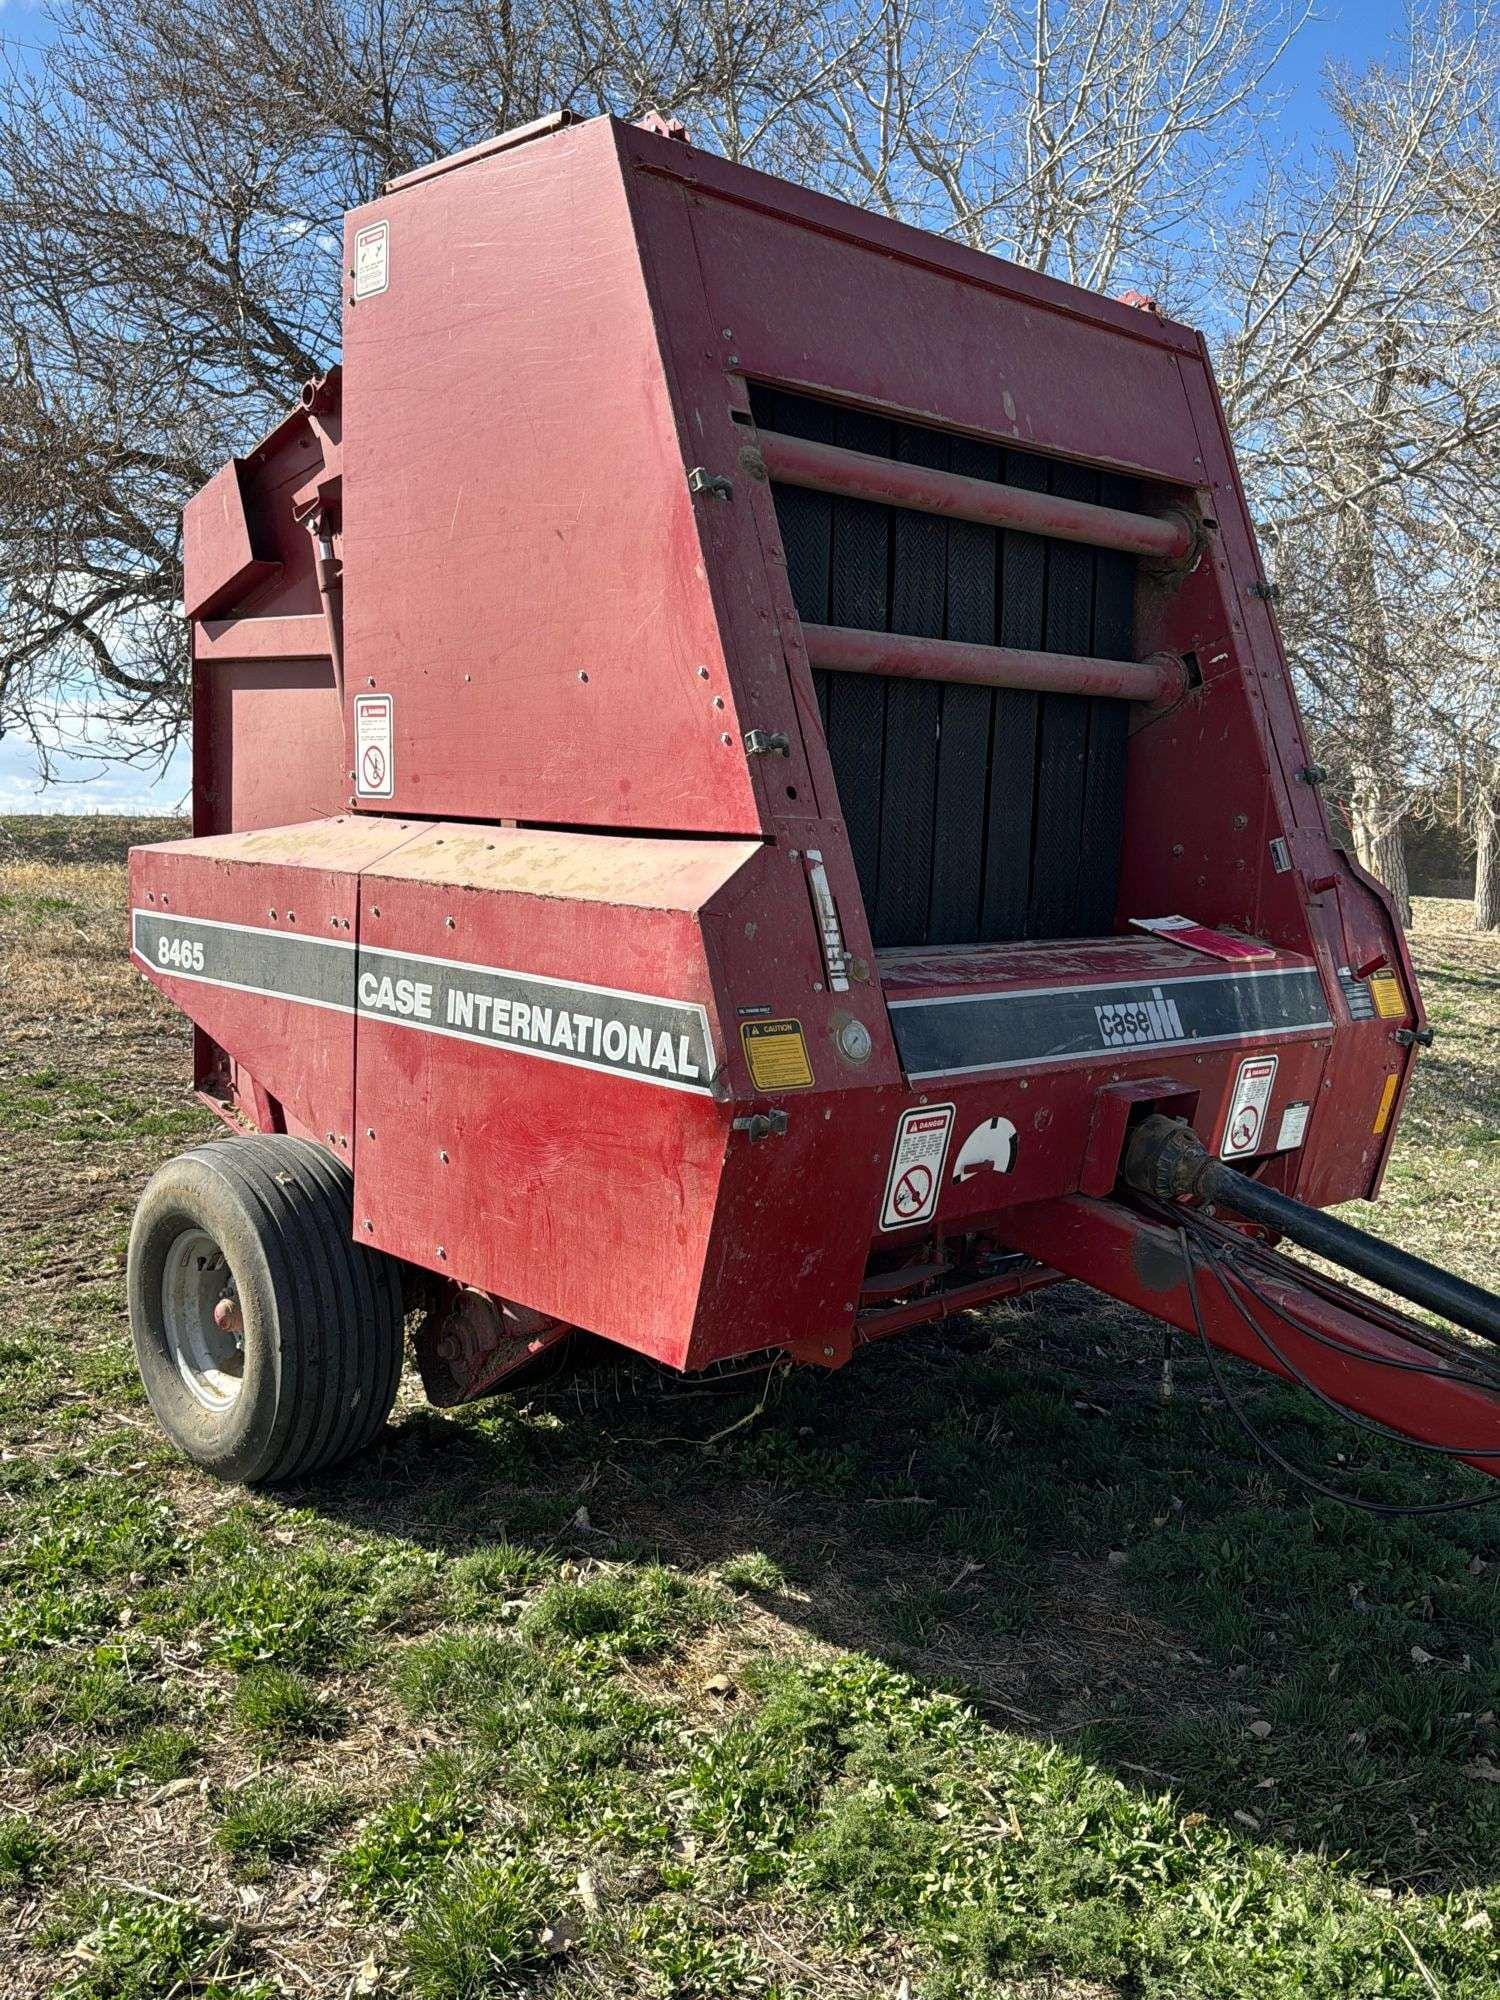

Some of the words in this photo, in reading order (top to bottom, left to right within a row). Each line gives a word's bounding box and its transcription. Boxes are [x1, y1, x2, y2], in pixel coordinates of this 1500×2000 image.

[157, 936, 205, 971] 8465
[358, 972, 433, 1019] CASE
[446, 988, 700, 1078] INTERNATIONAL
[763, 1022, 793, 1034] CAUTION
